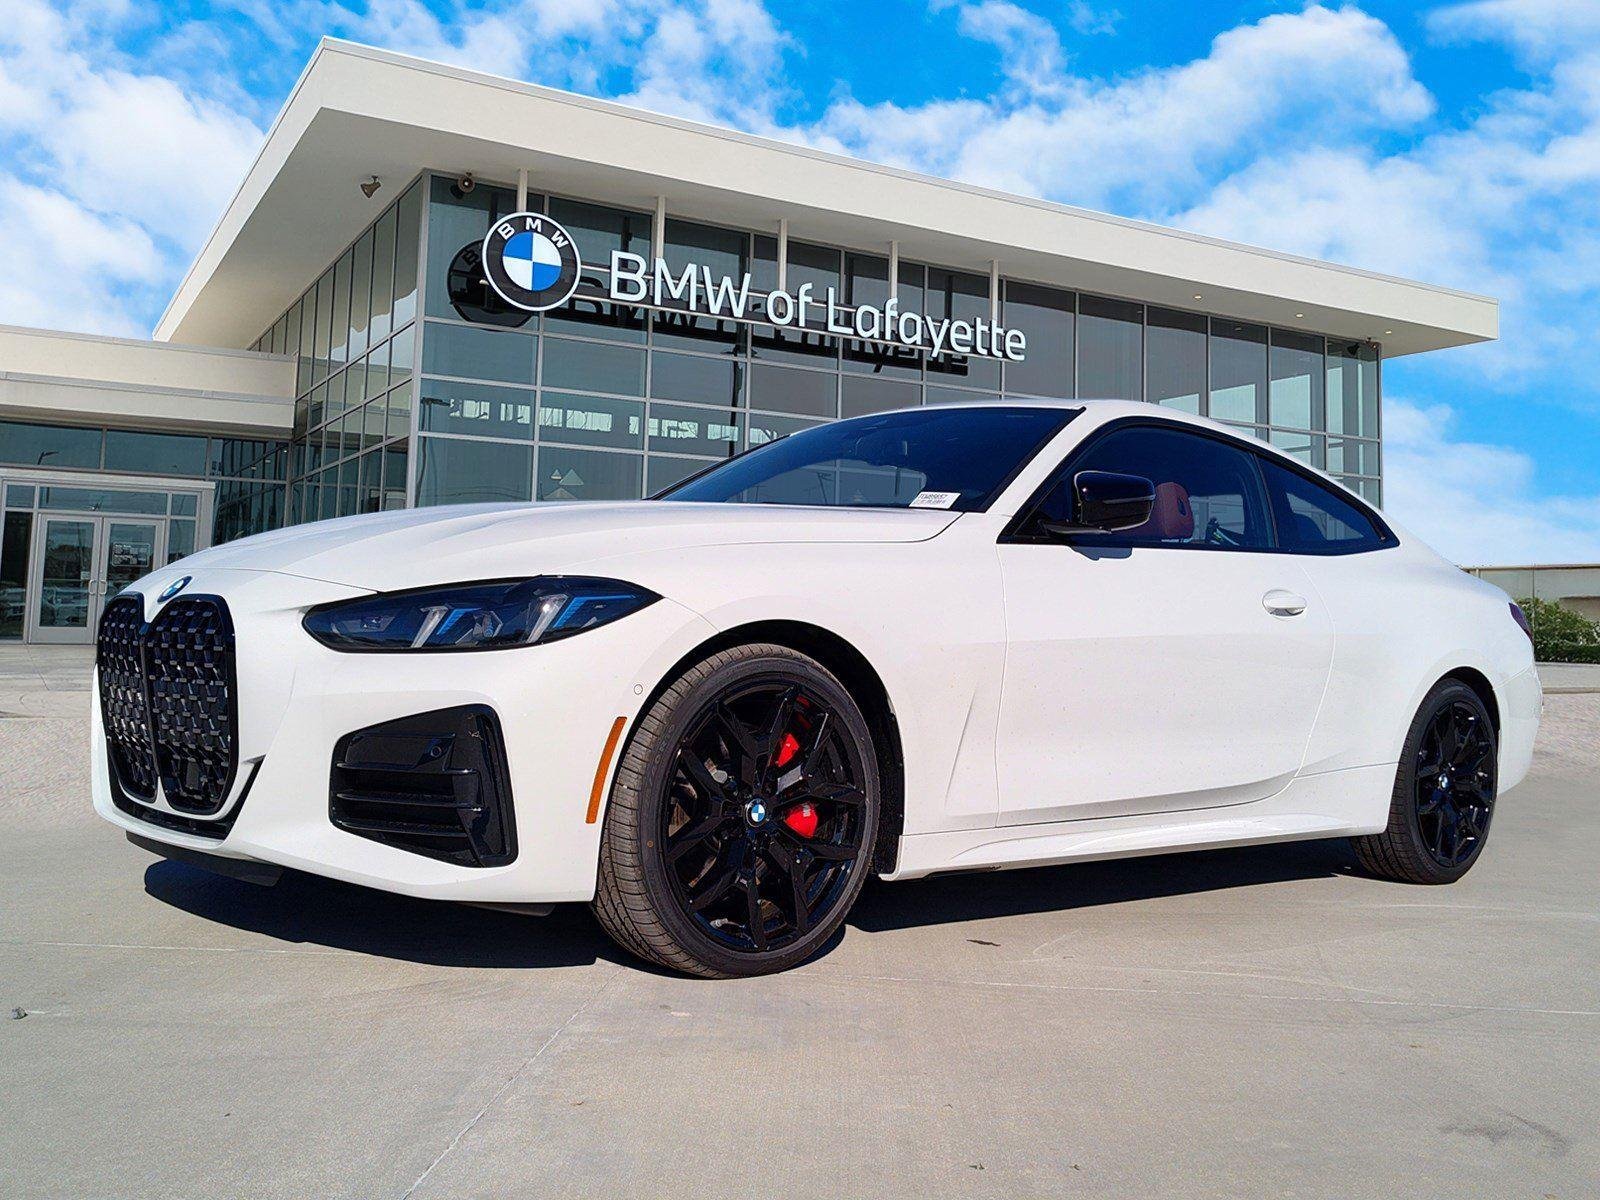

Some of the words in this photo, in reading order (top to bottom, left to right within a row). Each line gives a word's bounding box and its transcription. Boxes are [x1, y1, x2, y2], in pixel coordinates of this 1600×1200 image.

[497, 217, 569, 248] BMW
[610, 250, 751, 318] BMW
[766, 282, 813, 327] of
[827, 287, 1026, 361] Lafayette
